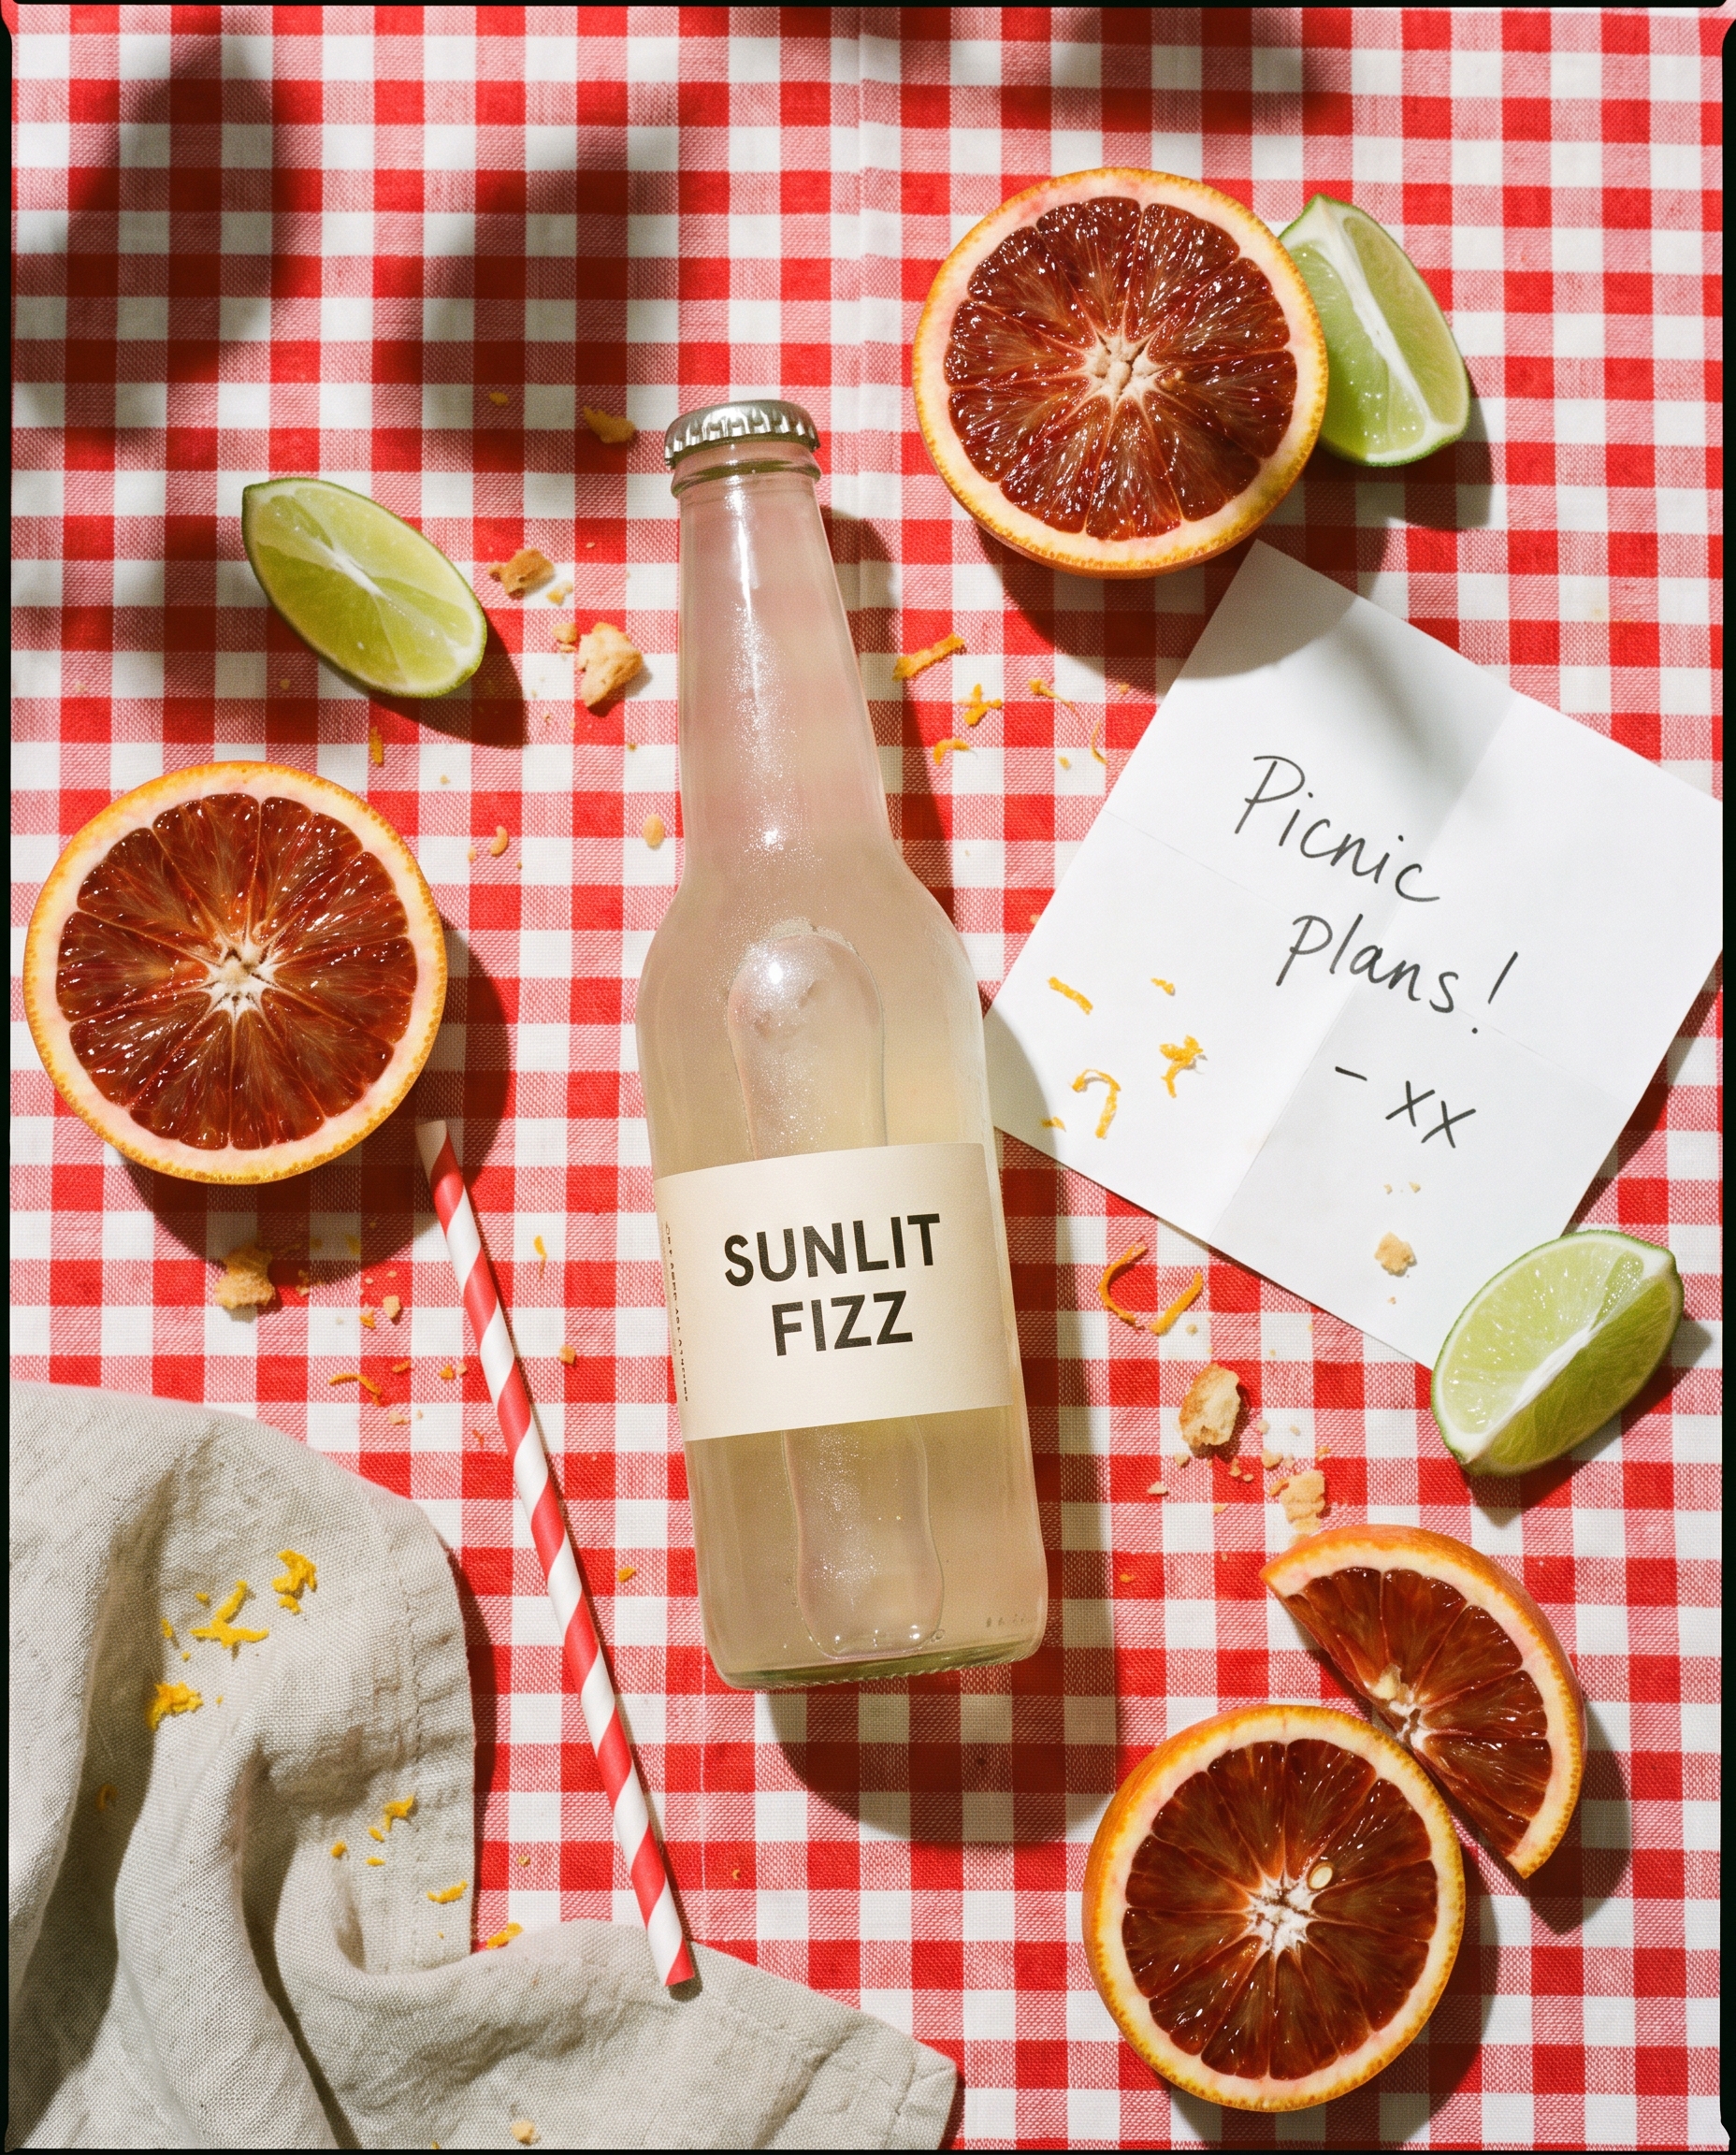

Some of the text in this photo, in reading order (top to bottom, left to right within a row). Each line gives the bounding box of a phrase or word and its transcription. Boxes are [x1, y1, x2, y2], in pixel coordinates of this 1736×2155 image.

[1234, 755, 1440, 902] Picnic
[723, 1212, 941, 1288] SUNLIT
[771, 1289, 914, 1357] FIZZ
